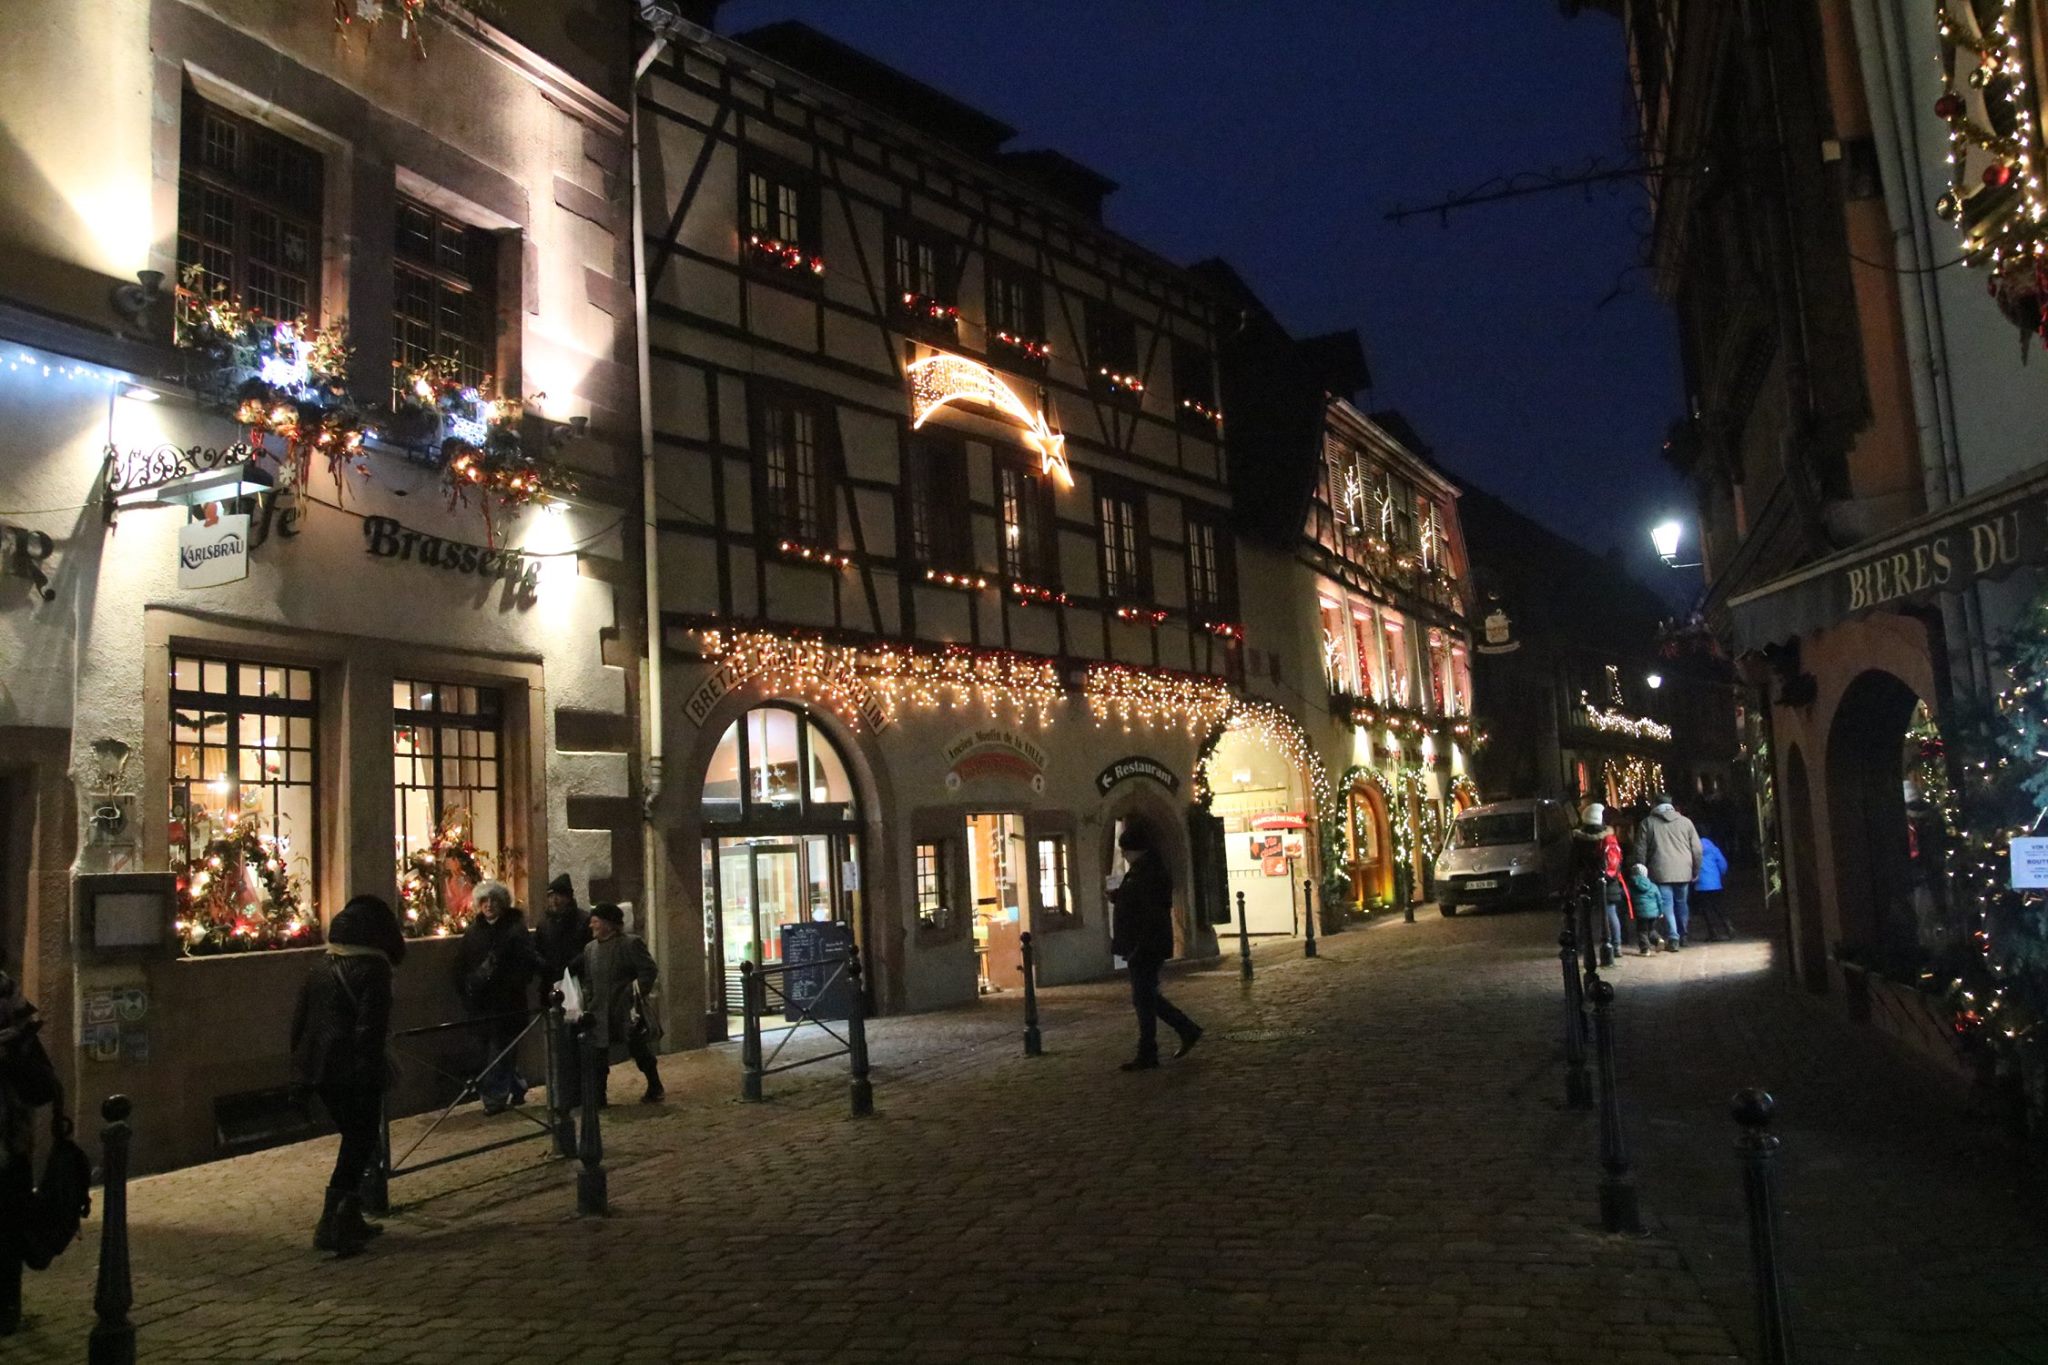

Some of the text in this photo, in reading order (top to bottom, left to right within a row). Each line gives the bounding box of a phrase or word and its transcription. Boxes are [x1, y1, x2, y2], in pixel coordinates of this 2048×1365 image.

[363, 515, 542, 586] Brasserie
[1848, 537, 1951, 611] BIERES
[1969, 511, 2020, 575] DU
[1114, 761, 1172, 785] Restaurant
